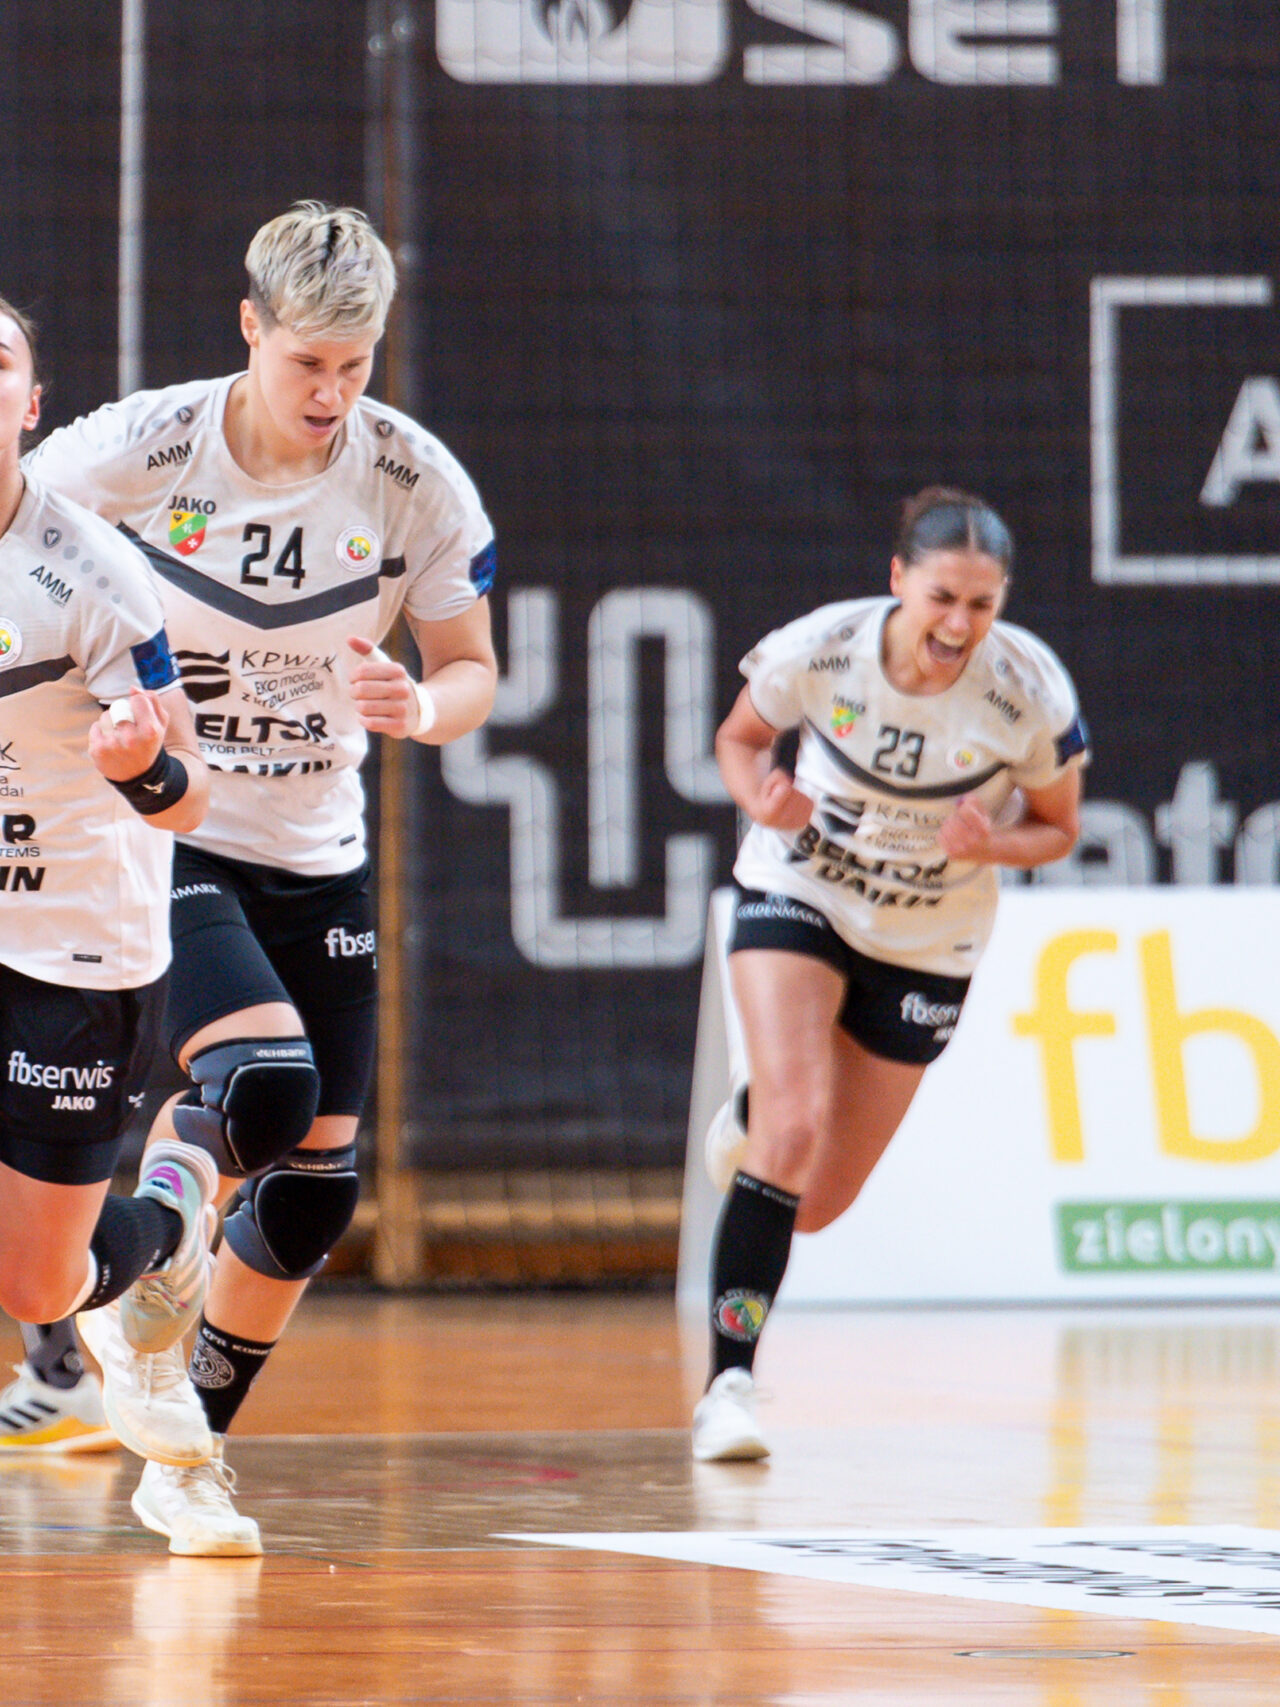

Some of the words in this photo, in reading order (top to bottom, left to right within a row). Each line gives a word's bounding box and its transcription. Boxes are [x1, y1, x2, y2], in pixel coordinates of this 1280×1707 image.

[147, 441, 193, 471] AMM
[374, 454, 420, 488] AMM
[168, 495, 217, 515] JAKO
[240, 522, 306, 589] 24
[29, 565, 74, 603] AMM
[808, 656, 850, 673] AMM
[983, 688, 1022, 722] AMM
[194, 711, 329, 744] ELTOR
[199, 743, 236, 755] EYOR
[871, 726, 925, 779] 23
[170, 882, 222, 900] NMARK
[8, 1050, 114, 1090] fbserwis
[51, 1095, 96, 1111] JAKO
